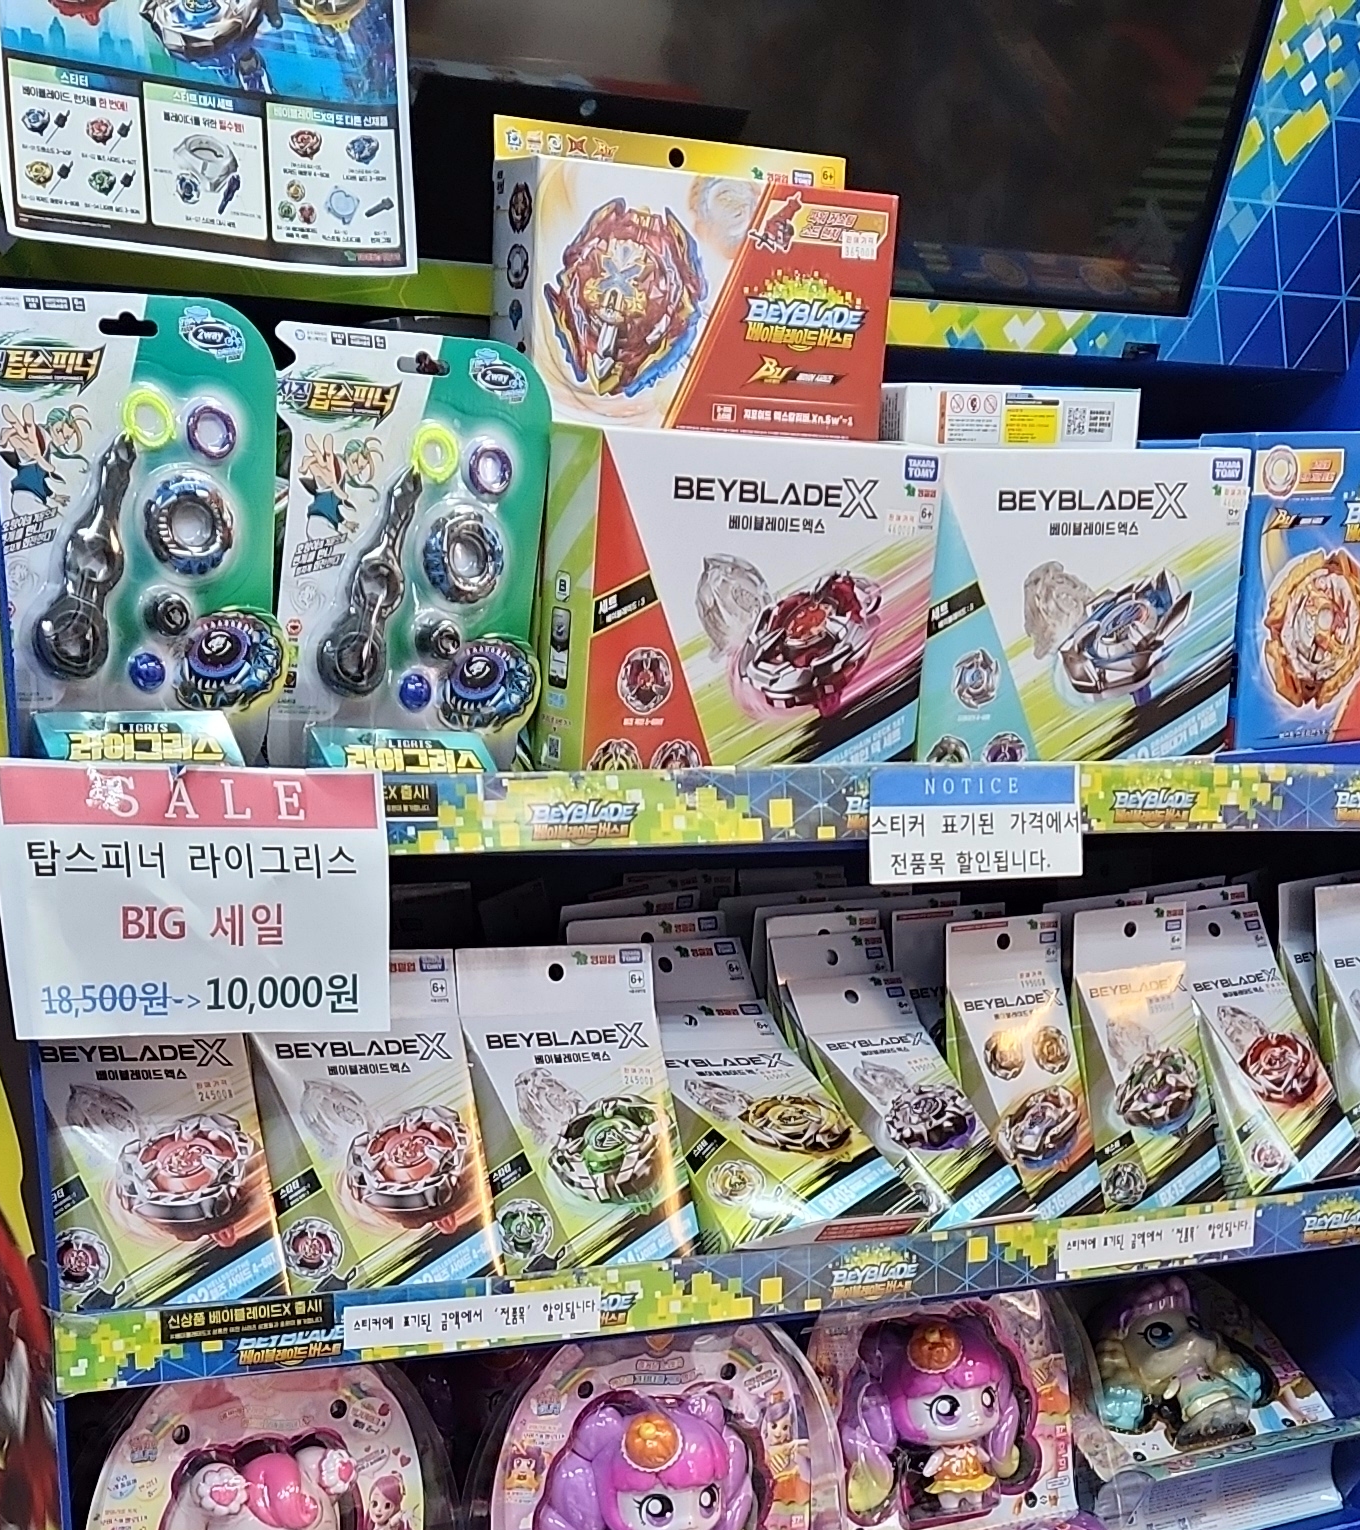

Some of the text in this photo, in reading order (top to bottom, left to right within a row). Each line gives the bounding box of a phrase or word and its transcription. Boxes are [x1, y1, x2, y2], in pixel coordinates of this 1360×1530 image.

[744, 298, 866, 330] BEYBLADE
[197, 328, 223, 343] 2way
[907, 467, 935, 479] TOMY
[908, 459, 936, 468] TAKARA
[1214, 468, 1240, 479] TOMY
[673, 475, 879, 519] BEYBLADEX
[998, 482, 1188, 519] BEYBLADEX
[921, 506, 933, 520] 6+
[119, 722, 170, 735] LIGRIS
[389, 739, 432, 750] LIGRIS
[925, 776, 1020, 795] NOTICE
[530, 803, 638, 824] BEYBLADE
[871, 812, 1080, 837] 스티커 표기된 가격에서
[27, 840, 358, 879] 탑스피너 라이그리스
[889, 848, 1052, 876] 전품목 할인됩니다.
[122, 904, 285, 947] BIG 세일
[432, 982, 446, 993] 6+
[630, 973, 644, 985] 6+
[206, 973, 360, 1015] 10,000원
[274, 1032, 453, 1060] BEYBLADEX
[485, 1022, 650, 1050] BEYBLADEX
[831, 1262, 920, 1286] BEYBLADE
[167, 1310, 206, 1329] 신상품
[208, 1302, 291, 1325] 베이블레이드X
[353, 1315, 394, 1332] 스티커에
[403, 1313, 431, 1332] 표기된
